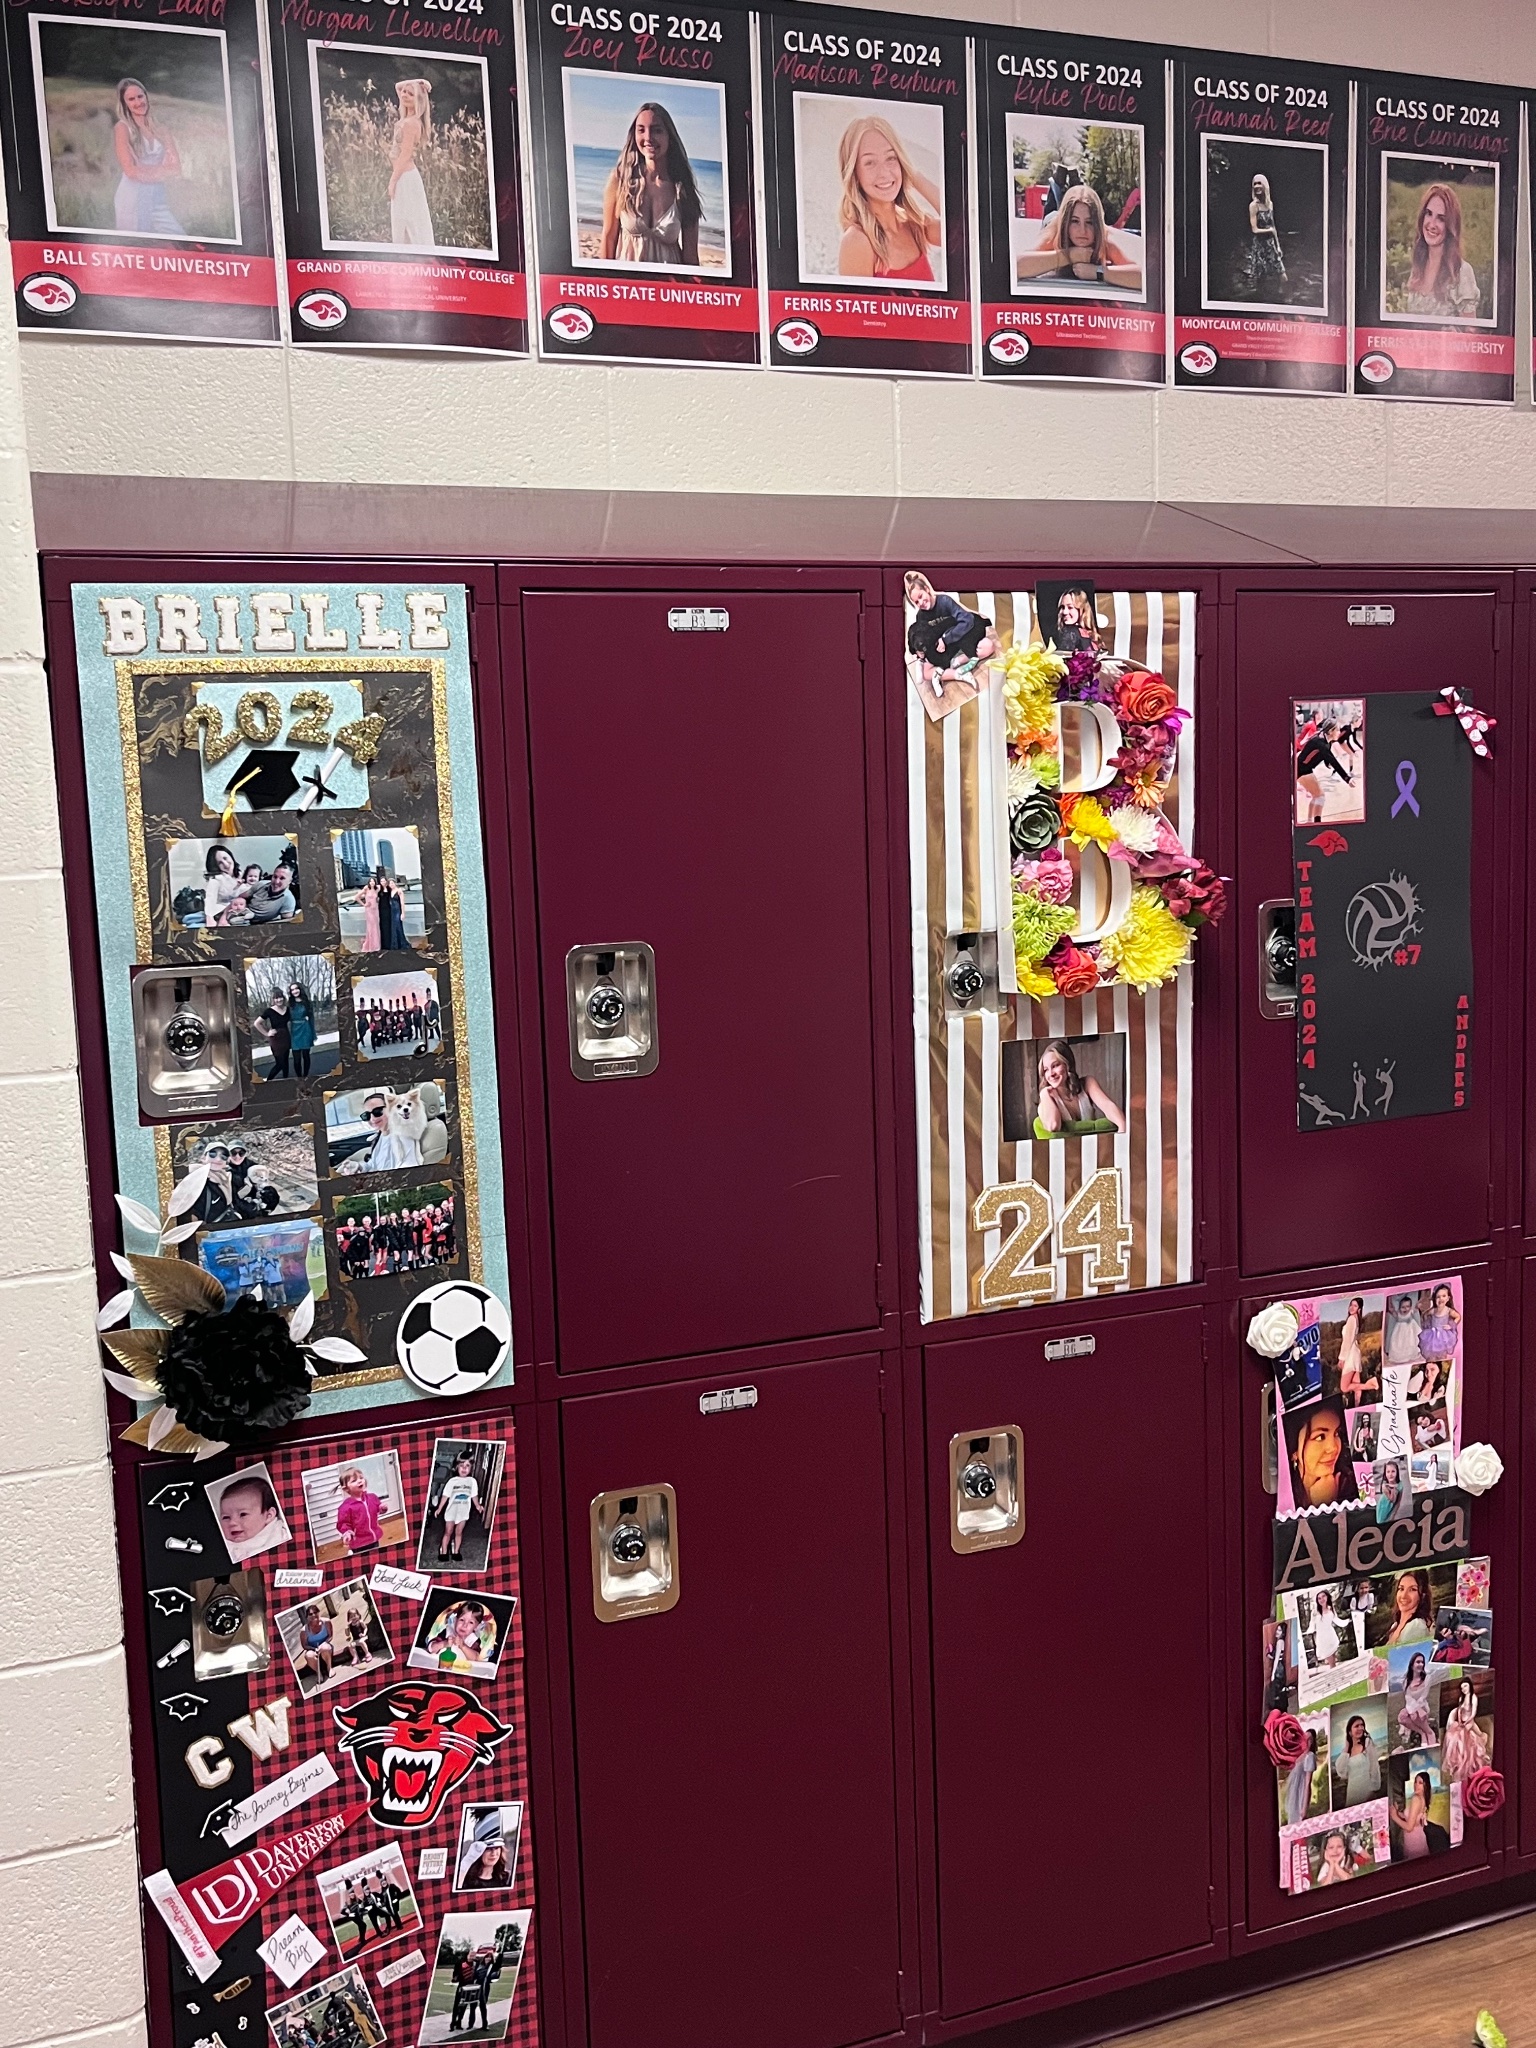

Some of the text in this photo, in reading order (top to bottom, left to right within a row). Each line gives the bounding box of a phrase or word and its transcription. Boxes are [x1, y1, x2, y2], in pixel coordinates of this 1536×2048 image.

[281, 0, 504, 54] Morgan Llewellyn
[551, 3, 722, 43] CLASS OF 2024
[564, 26, 713, 70] Zoey Russo
[784, 30, 942, 67] CLASS OF 2024
[774, 52, 960, 98] Madison Reyburn
[997, 54, 1143, 88] CLASS OF 2024
[1013, 77, 1138, 114] Kylie Poole
[1194, 76, 1328, 109] CLASS OF 2024
[1376, 97, 1500, 128] CLASS OF 2024
[1190, 99, 1334, 140] Hannah Reed
[1368, 116, 1511, 160] Brie Cummings
[43, 248, 251, 278] BALL STATE UNIVERSITY
[297, 261, 515, 285] GRAND RAPIDS COMMUNITY COLLEGE
[559, 281, 742, 307] FERRIS STATE UNIVERSITY
[784, 296, 959, 320] FERRIS STATE UNIVERSITY
[996, 311, 1156, 333] FERRIS STATE UNIVERSITY
[1182, 318, 1241, 331] MONTCALM
[1243, 321, 1304, 334] COMMUNITY
[1367, 335, 1404, 349] FERRIS
[1448, 341, 1505, 355] NIVERSITY
[99, 591, 451, 656] BRIELLE
[182, 688, 388, 766] 2024
[1297, 861, 1317, 1069] TEAM 2024
[1394, 944, 1422, 967] #7
[1454, 995, 1470, 1107] ANDRES
[972, 1166, 1134, 1307] 24
[1380, 1369, 1407, 1454] Graduate
[1274, 1498, 1469, 1592] Alecia
[276, 1572, 321, 1585] dreams!
[392, 1575, 425, 1592] Luck
[230, 1767, 324, 1831] The Journey Begins
[246, 1813, 344, 1878] DAVENPORT
[262, 1818, 346, 1889] UNIVERSITY
[162, 1896, 208, 1960] #PantherProud
[266, 1924, 306, 1965] Dream
[284, 1940, 313, 1971] Big
